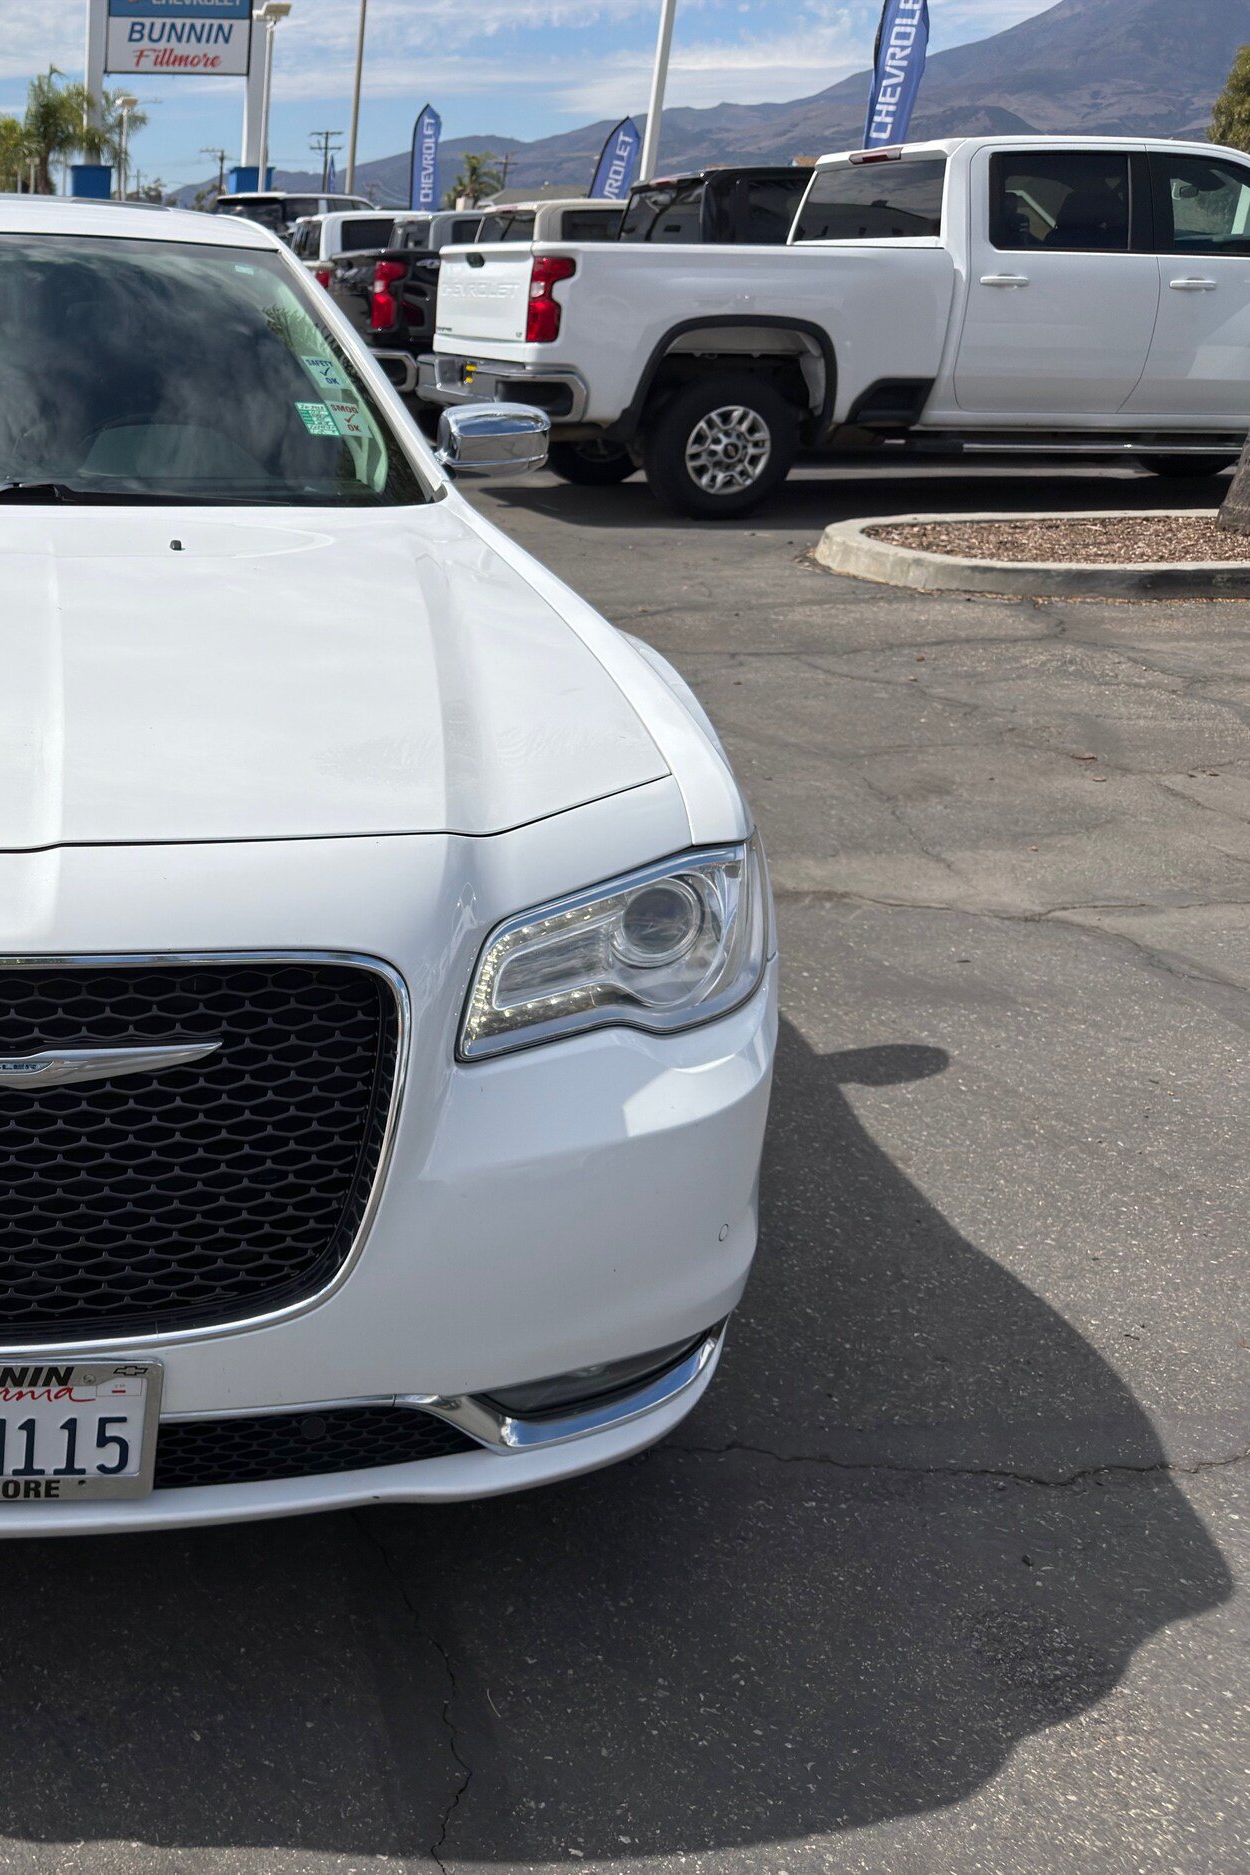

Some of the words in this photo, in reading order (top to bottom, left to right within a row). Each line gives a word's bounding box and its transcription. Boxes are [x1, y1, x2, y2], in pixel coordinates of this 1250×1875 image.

[127, 22, 234, 44] BUNNIN
[132, 48, 222, 68] Fillmore
[420, 115, 436, 202] CHEVROLET
[304, 359, 333, 367] SAFETY
[325, 377, 340, 385] OK
[330, 404, 359, 414] SMOG
[347, 424, 361, 432] OK
